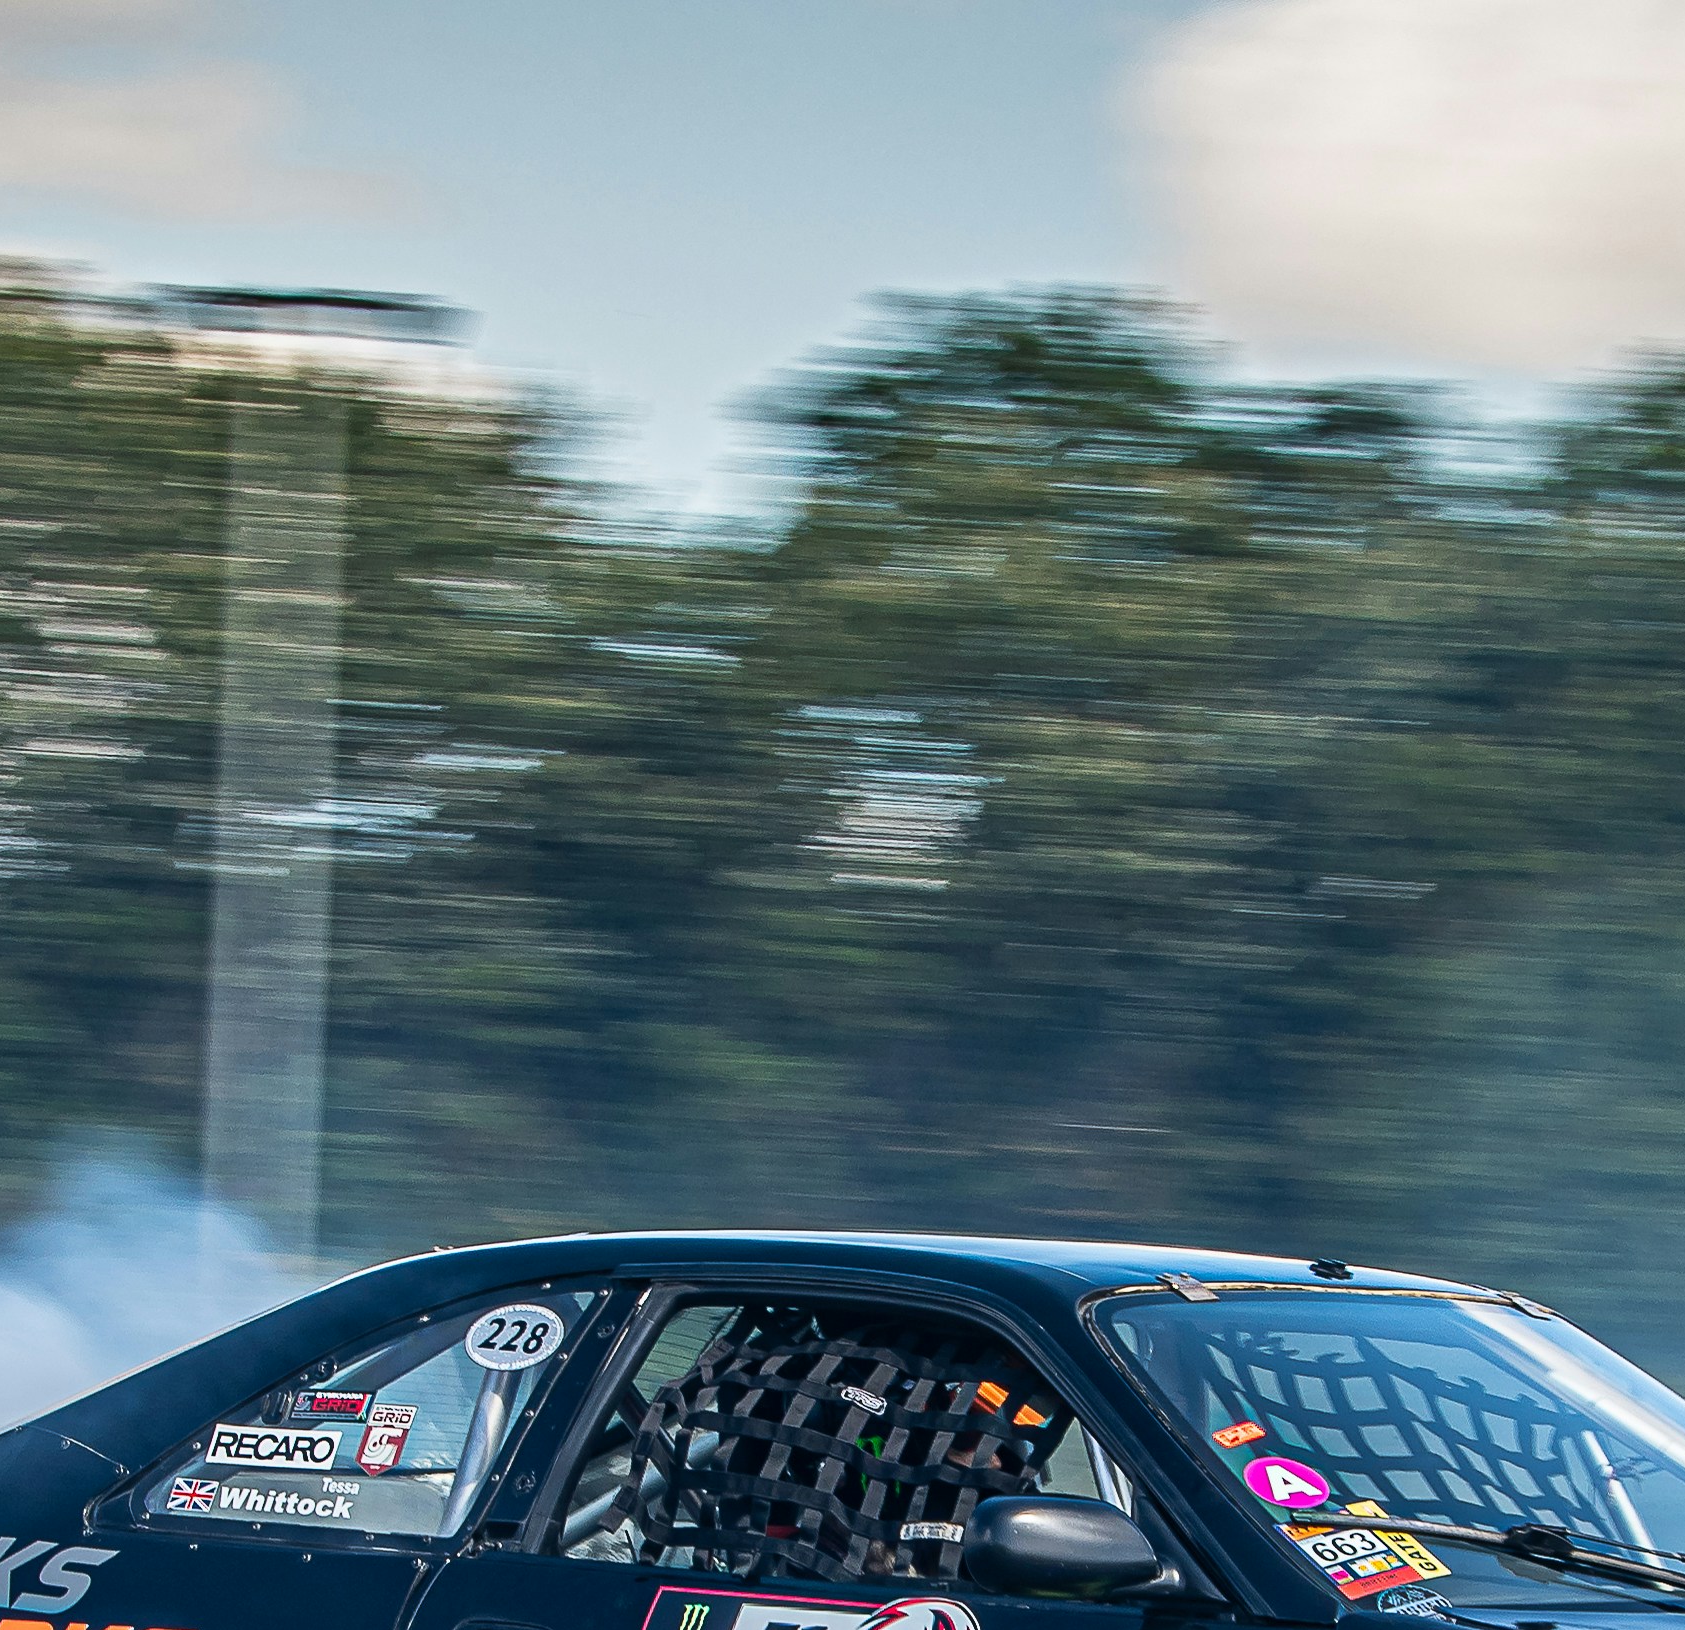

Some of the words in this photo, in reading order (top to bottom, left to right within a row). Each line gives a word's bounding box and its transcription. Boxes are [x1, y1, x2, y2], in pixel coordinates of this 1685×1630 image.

[477, 1317, 550, 1355] 228
[211, 1431, 335, 1463] RECARO
[322, 1477, 360, 1495] Tessa
[1265, 1464, 1322, 1501] A
[220, 1487, 354, 1519] Whittock
[1312, 1532, 1376, 1562] 663
[1387, 1534, 1438, 1572] GATE
